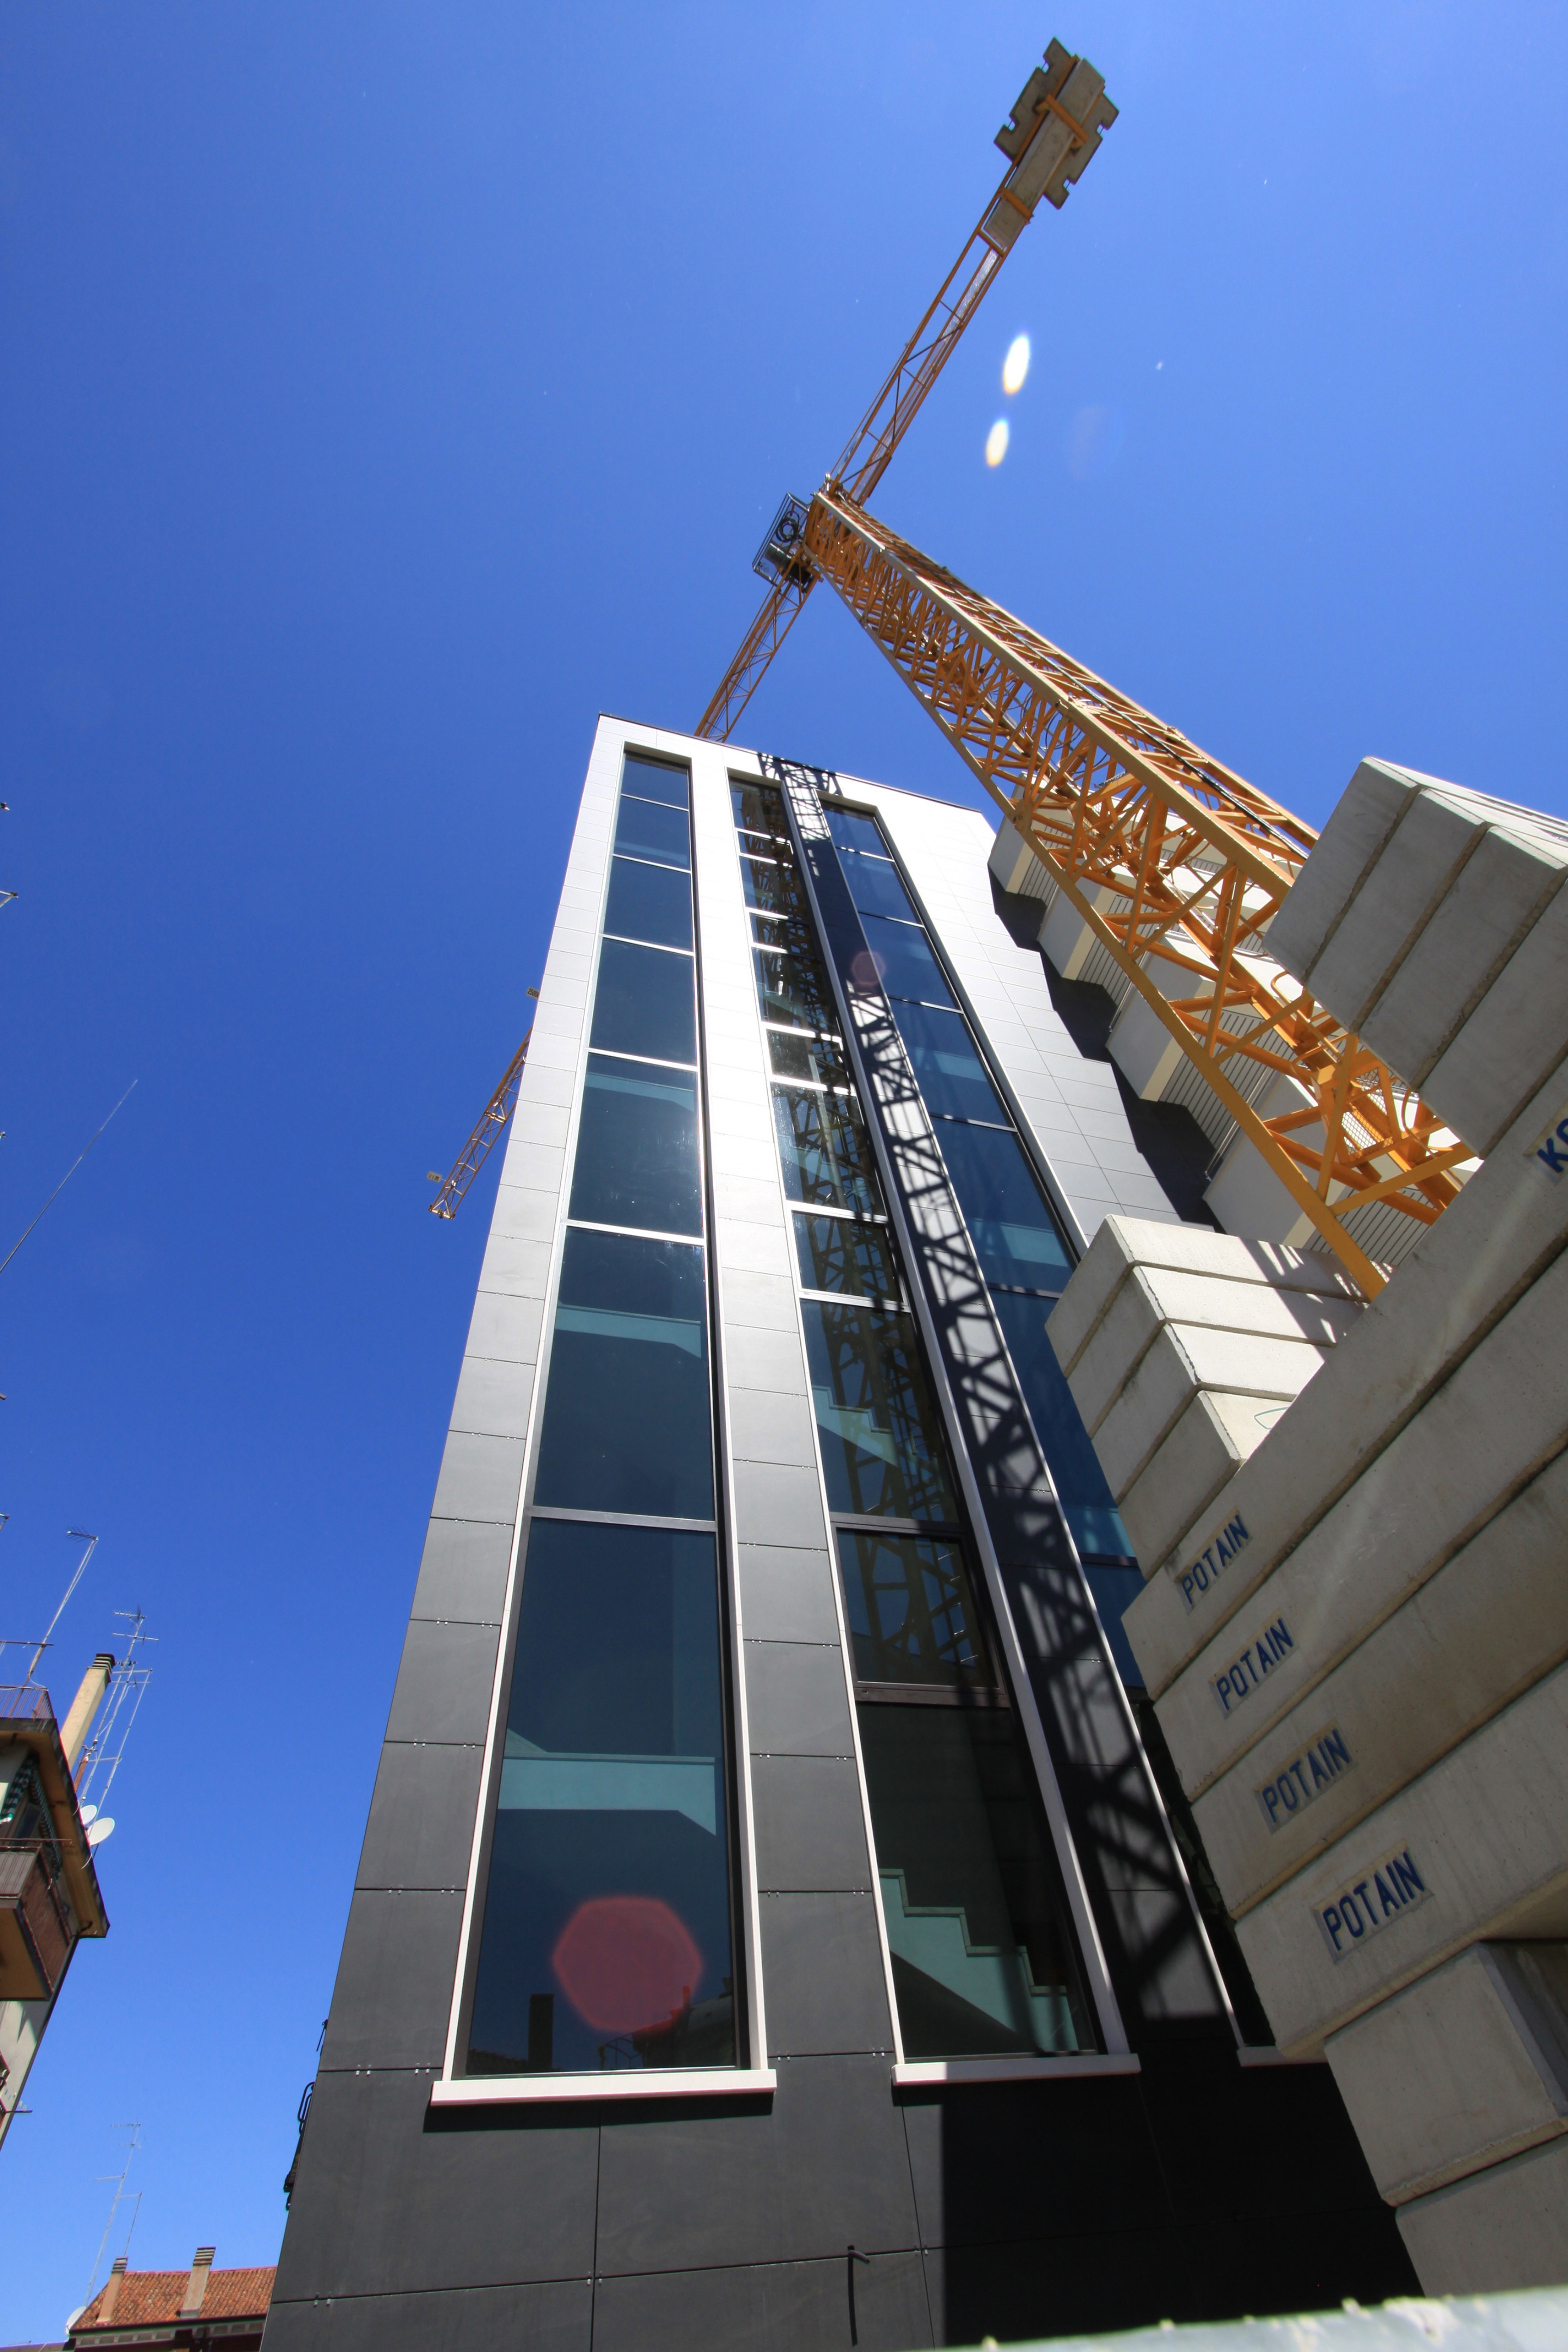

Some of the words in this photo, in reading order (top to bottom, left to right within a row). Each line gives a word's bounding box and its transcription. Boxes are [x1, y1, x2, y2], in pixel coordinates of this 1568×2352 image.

[1181, 1515, 1249, 1604] POTAIN
[1216, 1618, 1294, 1710] POTAIN
[1261, 1729, 1351, 1822] POTAIN
[1322, 1852, 1425, 1950] POTAIN
